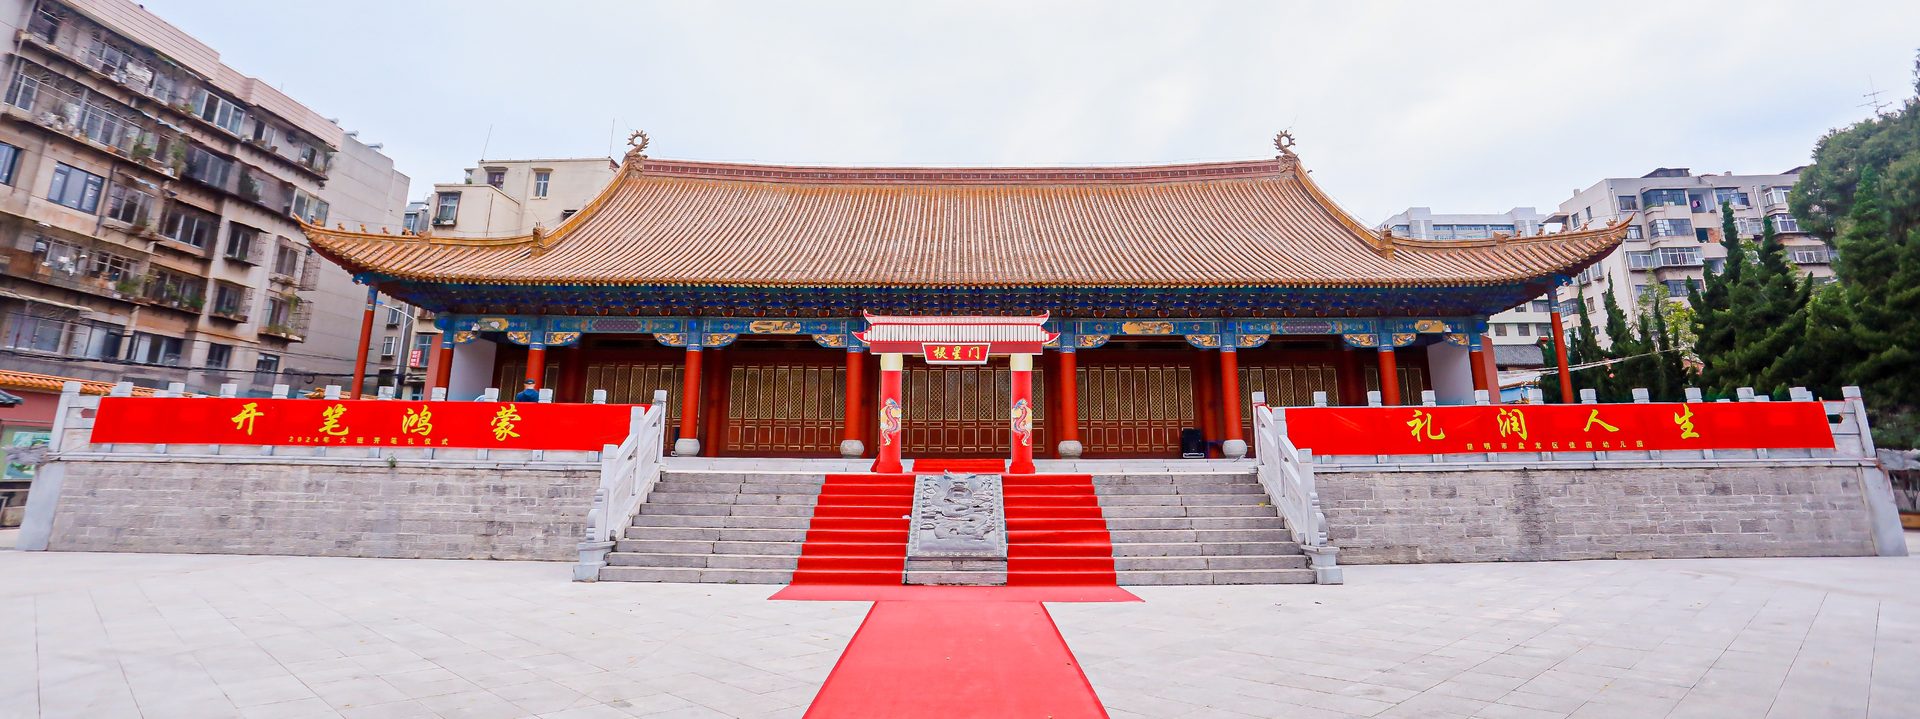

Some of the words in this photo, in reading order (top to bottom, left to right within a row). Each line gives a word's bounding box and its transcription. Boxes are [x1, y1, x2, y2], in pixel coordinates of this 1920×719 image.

[231, 402, 522, 441] 开笔鸿蒙
[1406, 403, 1700, 442] 礼润人生
